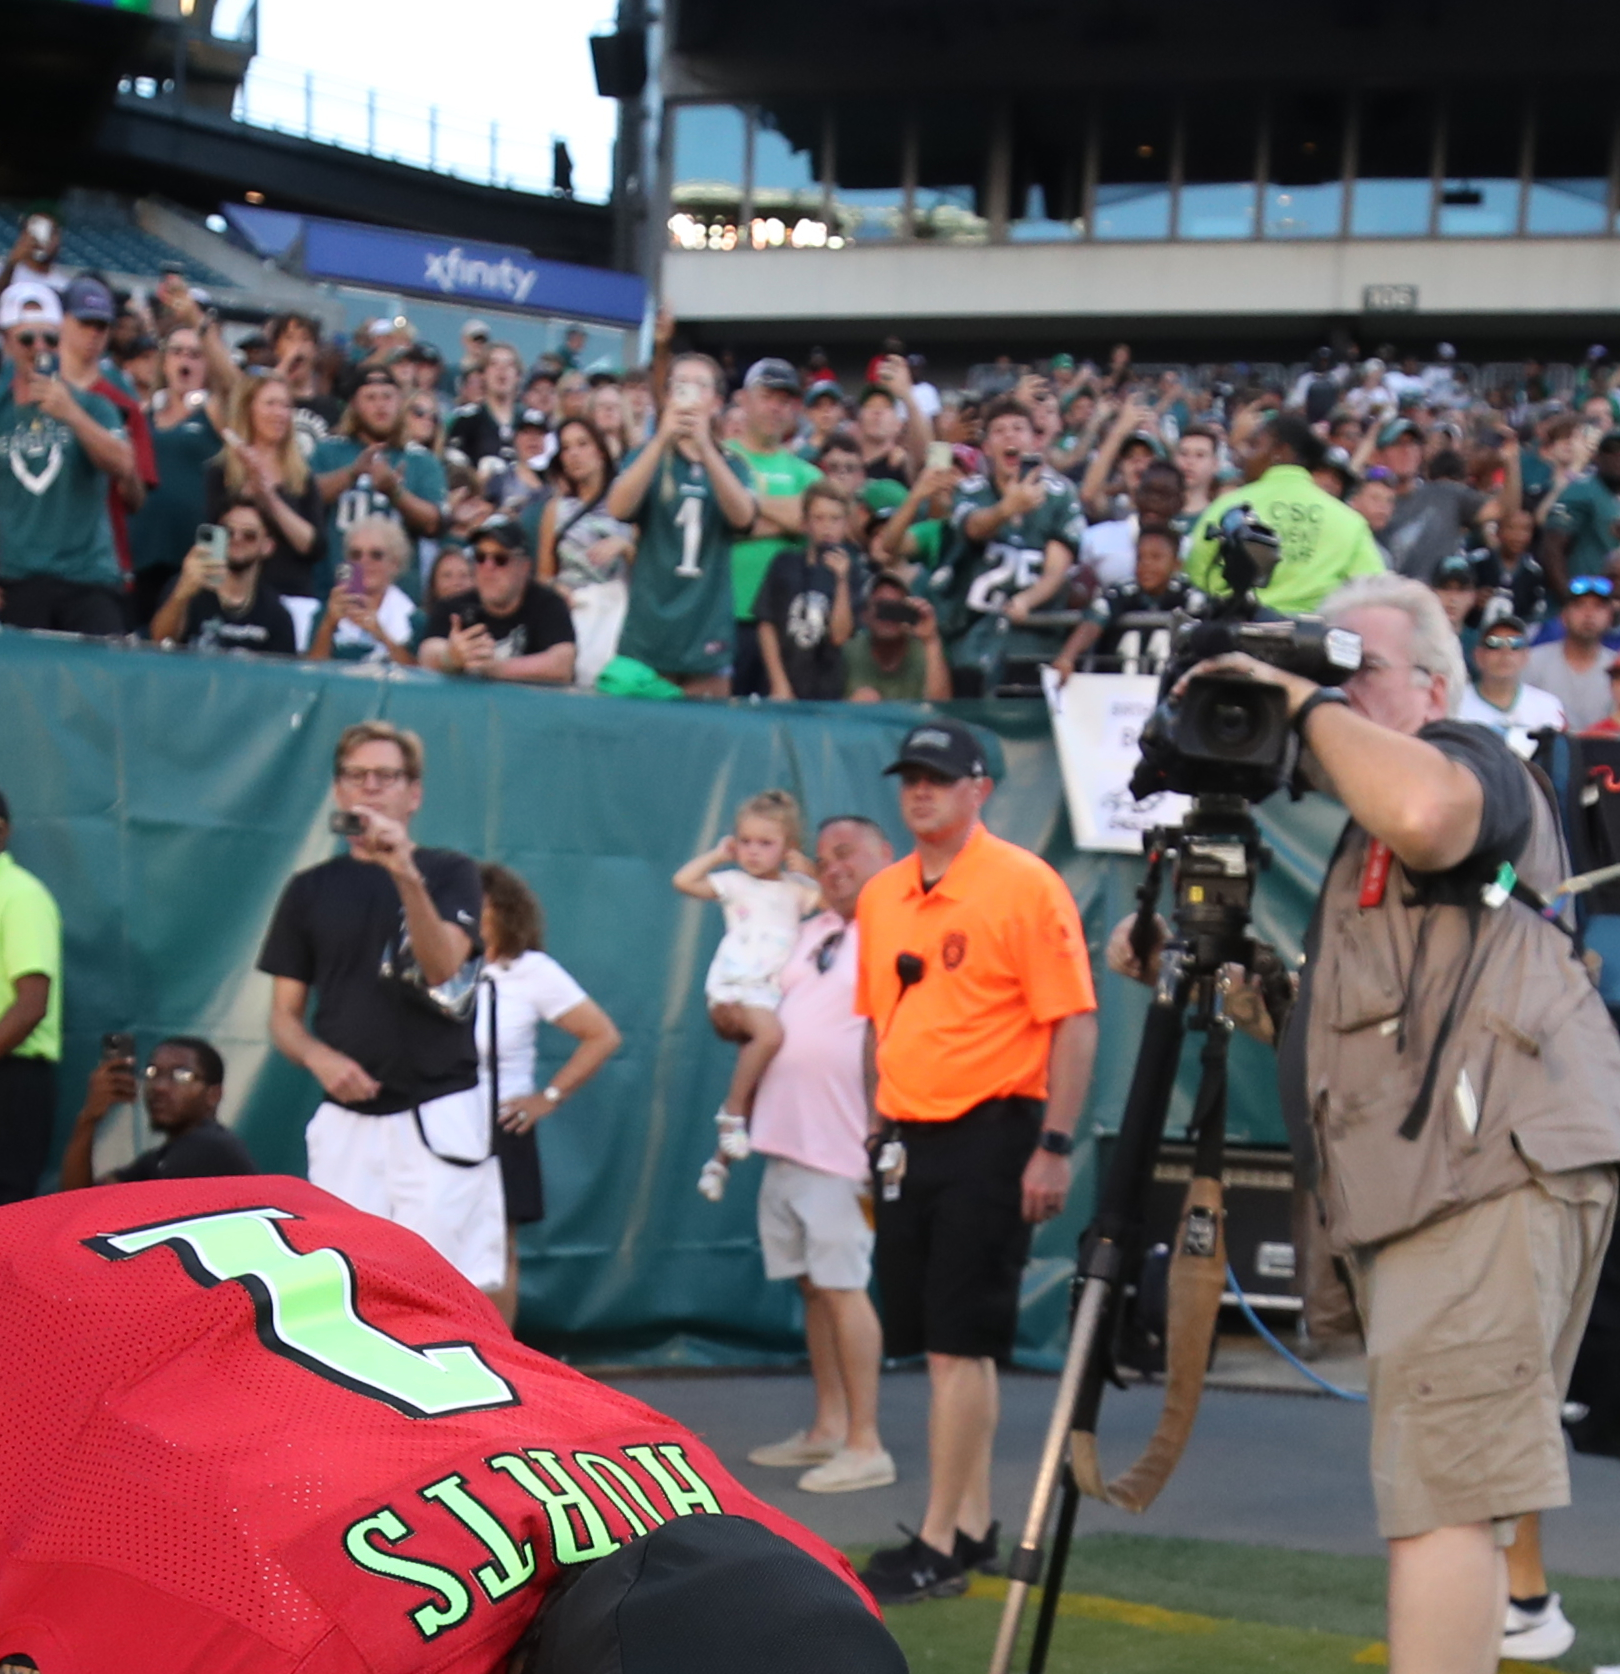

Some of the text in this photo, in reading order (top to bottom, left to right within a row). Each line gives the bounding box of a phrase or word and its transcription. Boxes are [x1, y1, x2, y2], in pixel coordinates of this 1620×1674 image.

[424, 248, 537, 304] xfinity
[674, 496, 704, 577] 1
[1270, 501, 1324, 523] CSC
[82, 1206, 522, 1420] 1
[344, 1442, 722, 1643] HURTS
